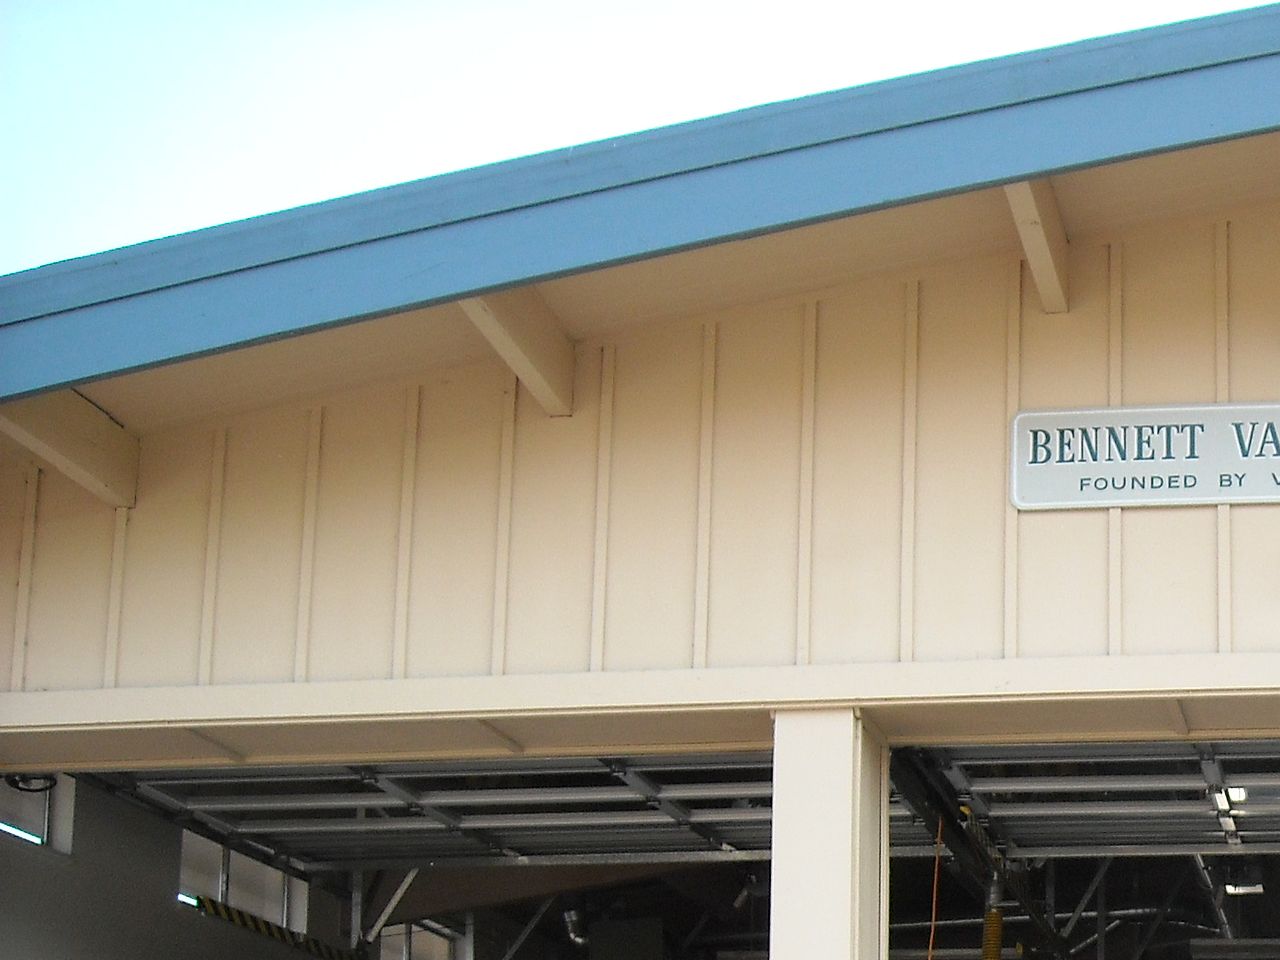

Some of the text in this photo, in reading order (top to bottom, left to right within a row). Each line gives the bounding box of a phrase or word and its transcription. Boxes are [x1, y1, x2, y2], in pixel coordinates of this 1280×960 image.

[1029, 423, 1204, 465] BENNETT
[1079, 475, 1198, 491] FOUNDED
[1219, 473, 1247, 487] BY
